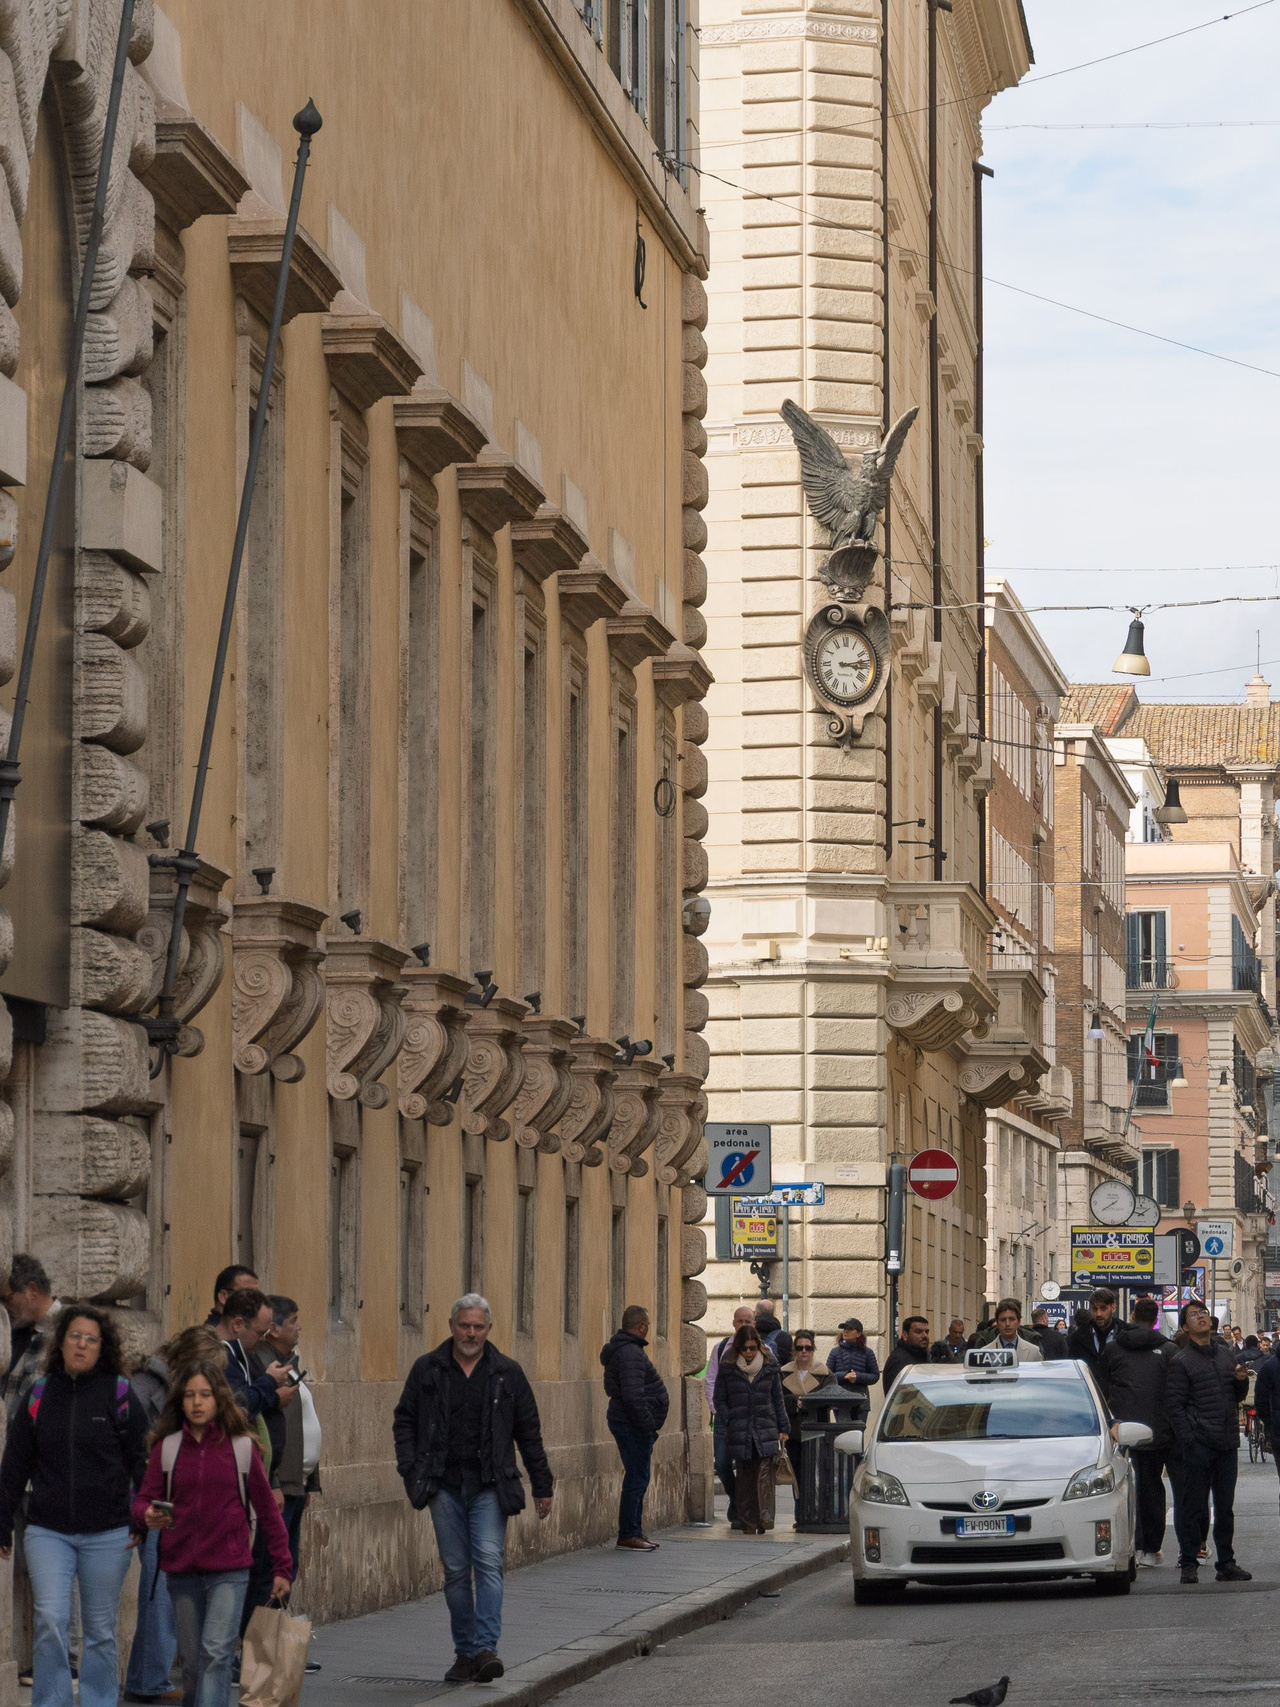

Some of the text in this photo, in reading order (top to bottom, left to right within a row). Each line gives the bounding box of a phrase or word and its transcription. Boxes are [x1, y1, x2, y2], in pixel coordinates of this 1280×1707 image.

[725, 1128, 748, 1136] area
[713, 1139, 760, 1148] pedonale
[1075, 1232, 1150, 1248] MARVIN & FRIENDS
[1103, 1252, 1129, 1261] dude
[973, 1352, 1008, 1364] TAXI
